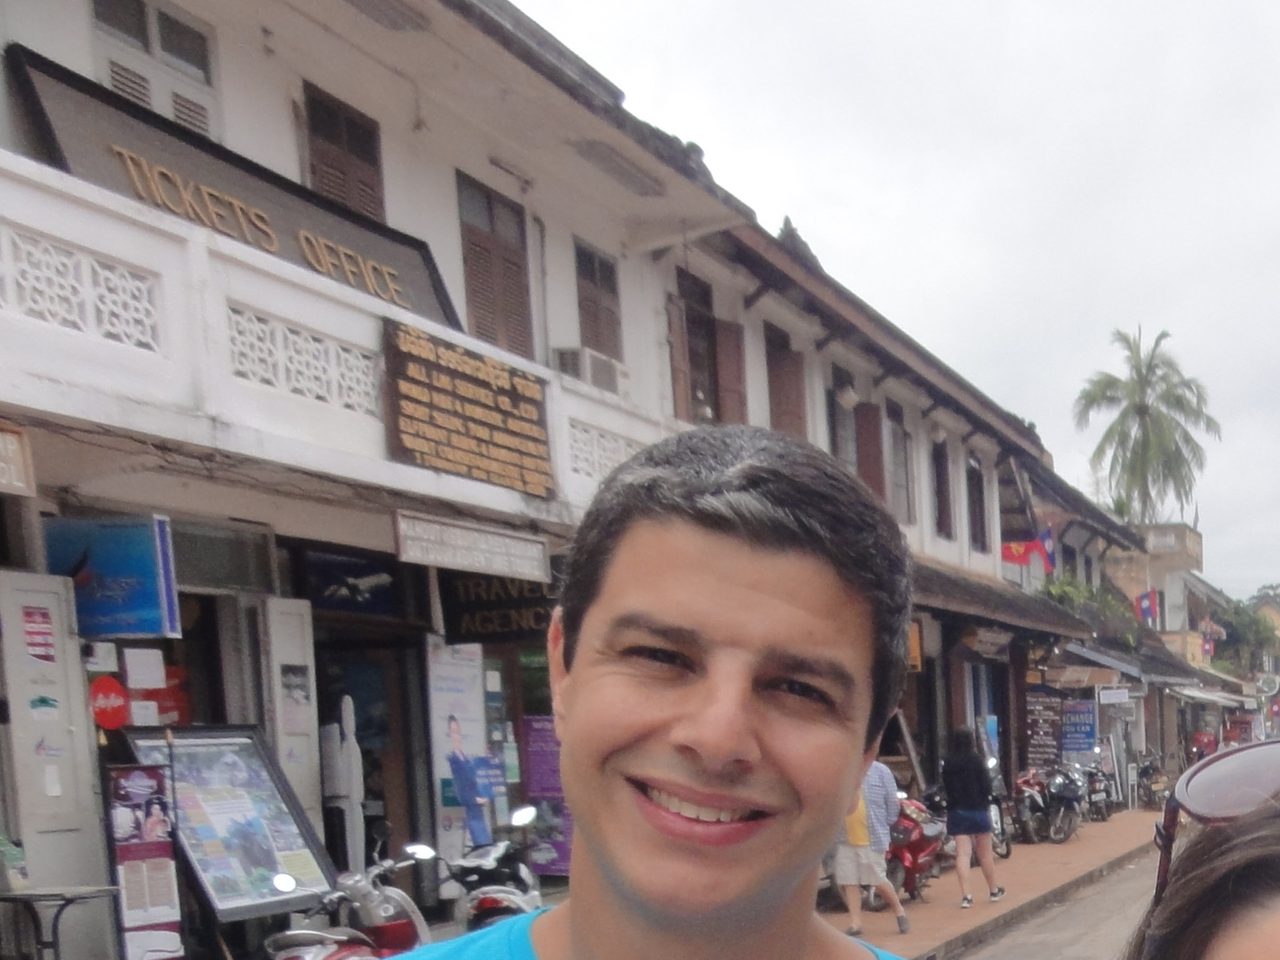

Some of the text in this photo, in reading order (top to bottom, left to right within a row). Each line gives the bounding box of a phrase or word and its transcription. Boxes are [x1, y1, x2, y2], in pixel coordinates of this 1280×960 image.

[110, 144, 411, 309] TICKETS OFFICE
[459, 574, 559, 601] TRAVEL
[461, 606, 551, 634] AGENC
